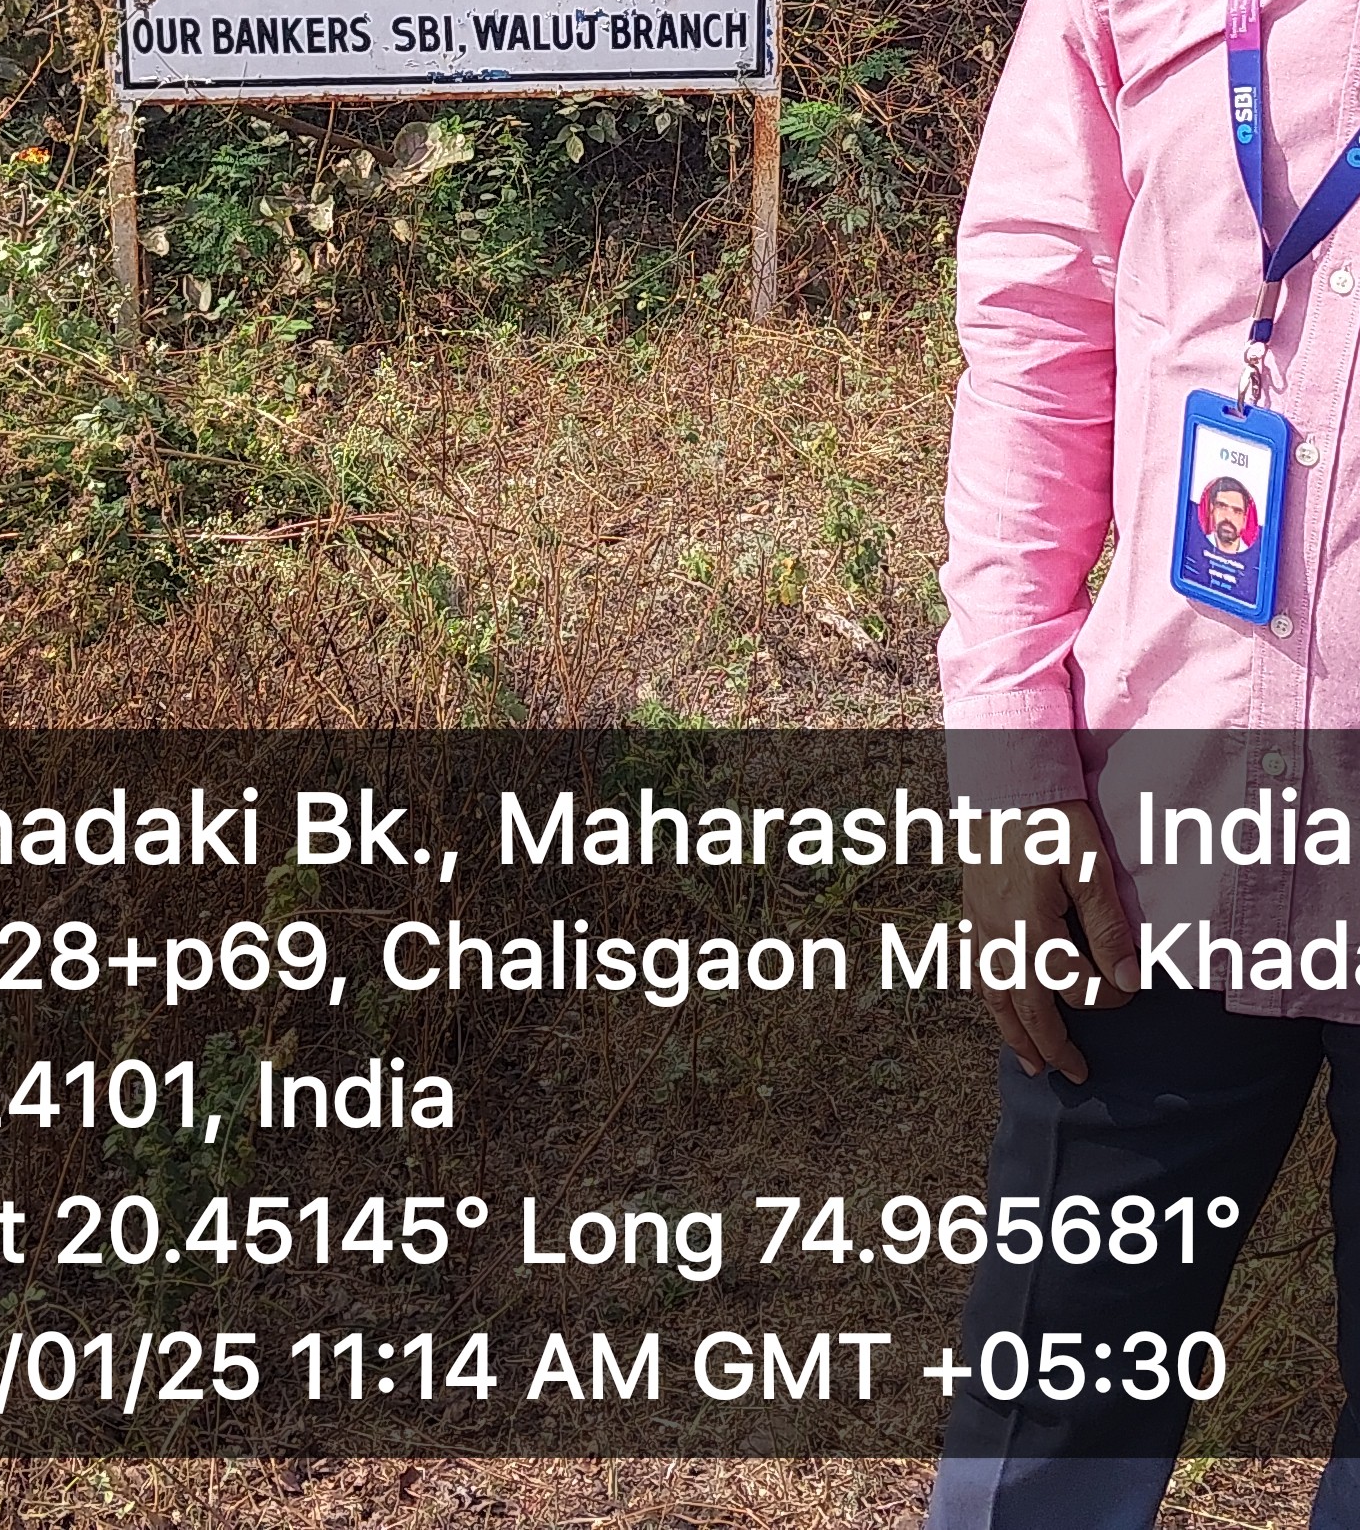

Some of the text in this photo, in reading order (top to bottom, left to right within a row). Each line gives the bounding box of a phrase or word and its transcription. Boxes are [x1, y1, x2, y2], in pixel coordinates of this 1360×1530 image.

[132, 16, 203, 55] OUR
[212, 14, 372, 55] BANKERS
[472, 12, 600, 51] WALUJ
[610, 11, 747, 50] BRANCH
[1233, 86, 1253, 123] SBI
[1230, 450, 1249, 469] SBI
